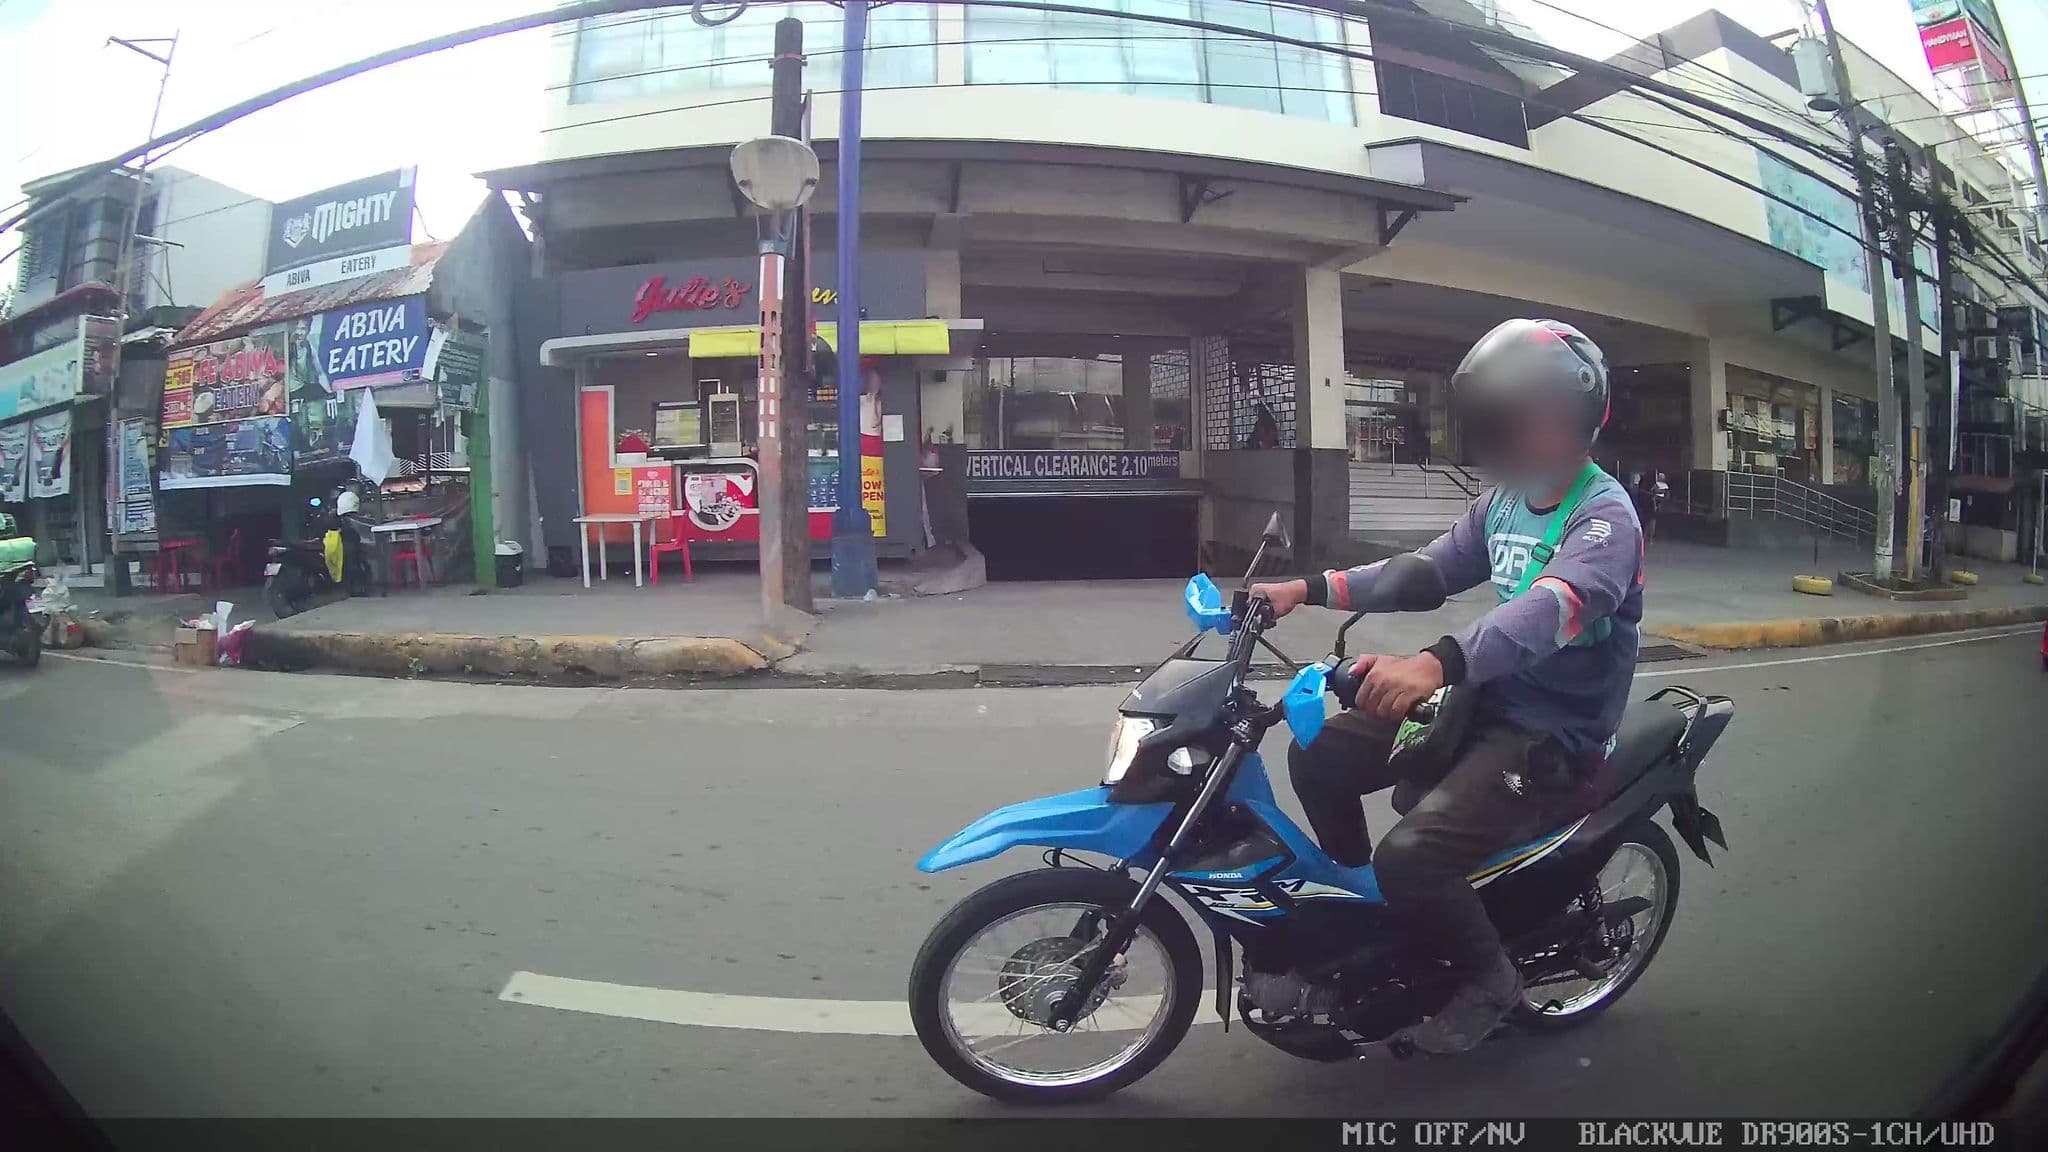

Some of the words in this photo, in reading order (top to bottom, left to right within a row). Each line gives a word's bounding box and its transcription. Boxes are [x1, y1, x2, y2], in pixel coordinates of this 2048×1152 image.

[312, 190, 397, 244] MIGHTY
[286, 269, 311, 287] ABIVA
[341, 255, 377, 274] EATERY
[631, 275, 751, 323] Julie's
[334, 304, 406, 341] ABIVA
[219, 347, 277, 383] ABIVA
[328, 336, 419, 375] EATERY
[213, 382, 260, 412] EATERY
[1034, 455, 1118, 477] CLEARANCE
[1121, 455, 1148, 477] 2.10
[1148, 454, 1179, 468] meters
[863, 481, 882, 490] OW
[863, 491, 884, 501] PEN
